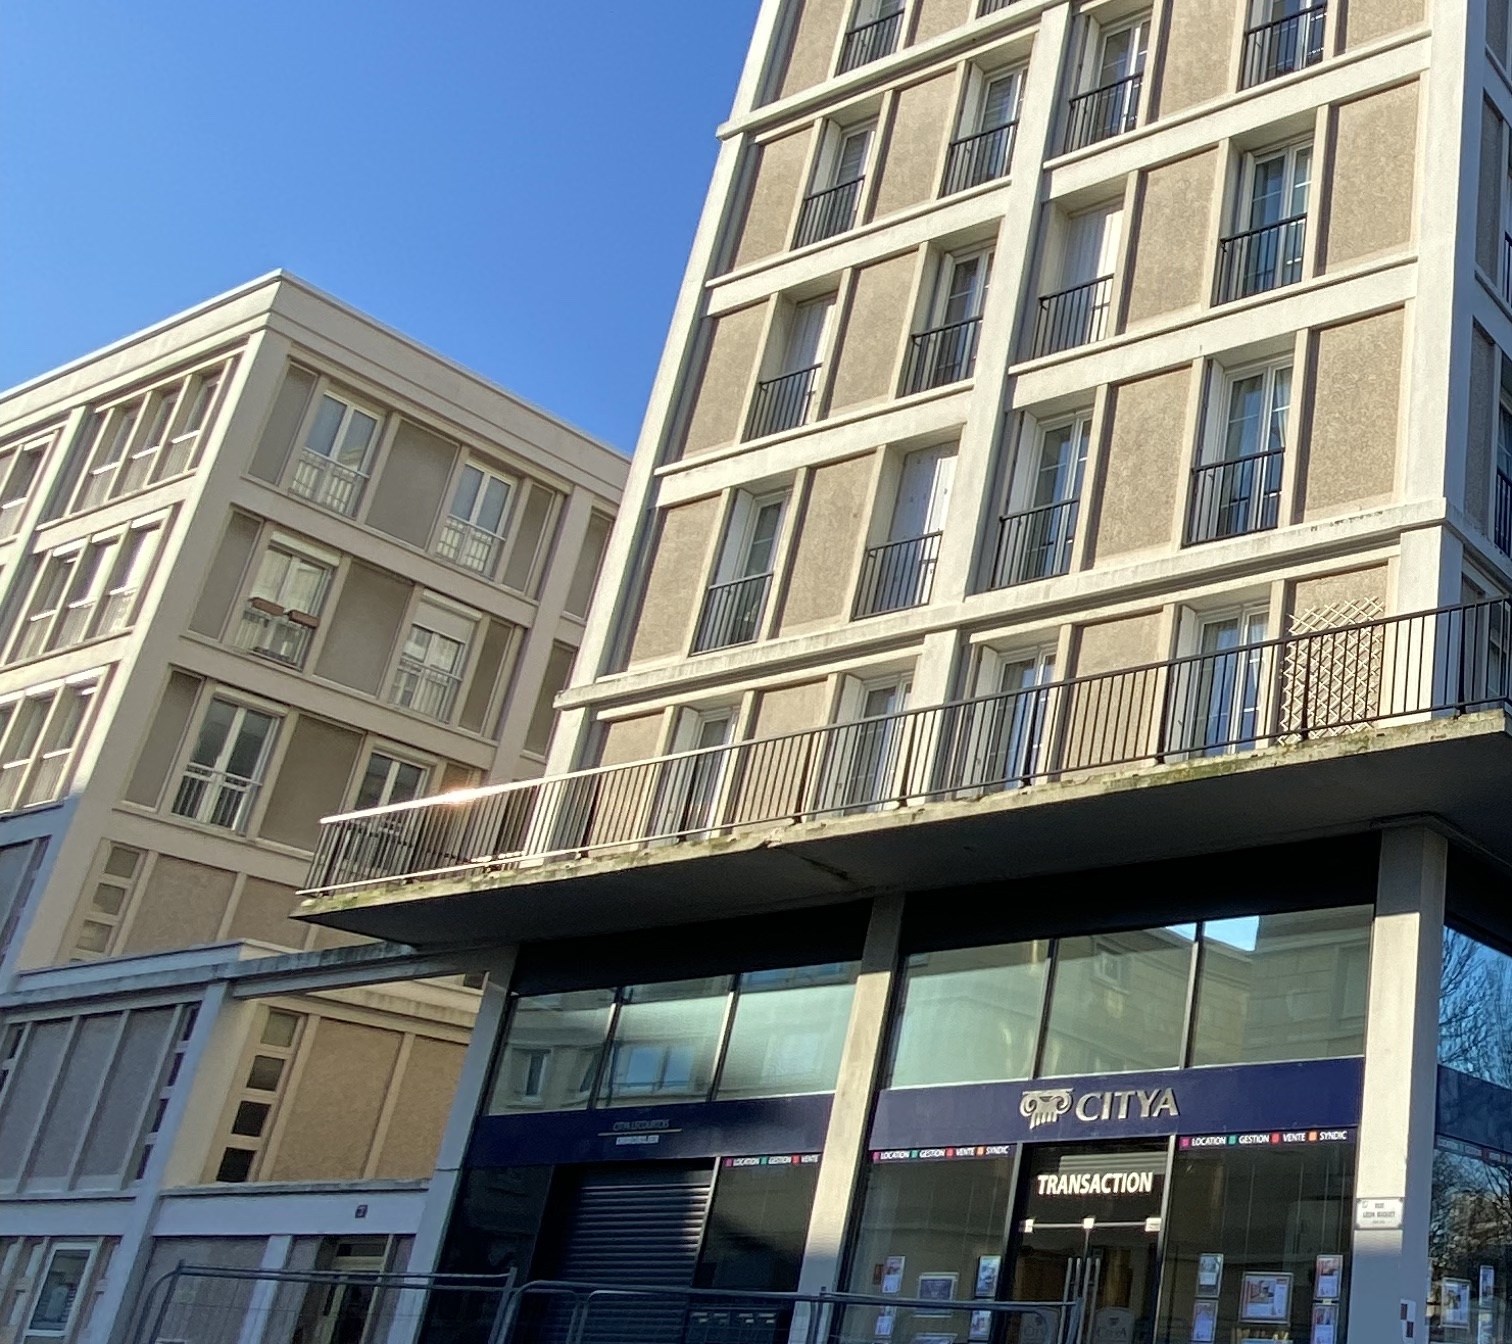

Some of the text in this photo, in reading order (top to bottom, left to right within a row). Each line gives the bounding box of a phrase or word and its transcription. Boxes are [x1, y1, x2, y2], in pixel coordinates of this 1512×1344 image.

[1075, 1088, 1179, 1122] CITYA
[1191, 1131, 1348, 1146] LOCATION GESTION VENTE SYNDIC
[880, 1146, 1009, 1160] LOCATION GESTION VENTE SYNDIC
[1037, 1172, 1153, 1195] TRANSACTION
